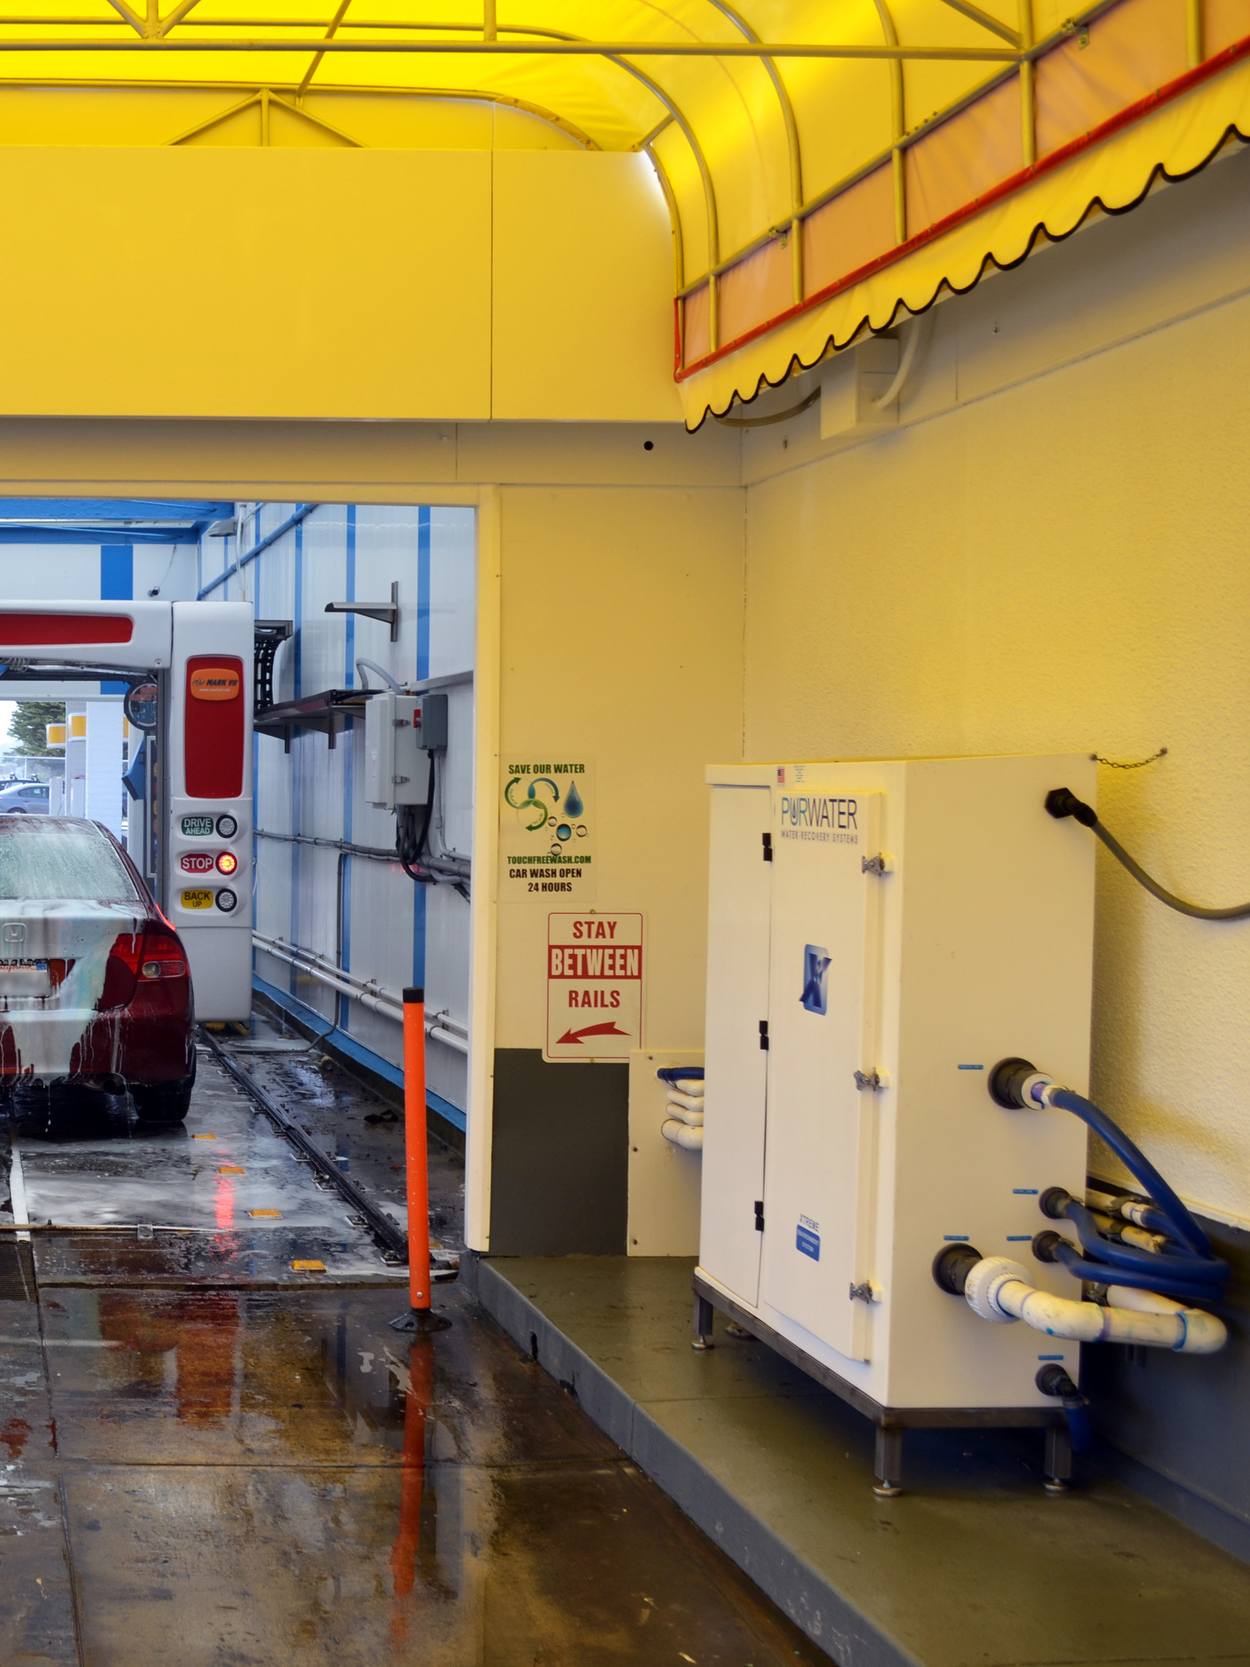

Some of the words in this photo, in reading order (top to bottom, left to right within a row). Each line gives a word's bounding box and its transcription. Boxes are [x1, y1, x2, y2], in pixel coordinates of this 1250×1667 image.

[509, 765, 531, 774] SAVE
[533, 764, 551, 773] OUR
[554, 764, 585, 773] WATER
[184, 819, 211, 827] DRIVE
[782, 830, 798, 839] WATER
[801, 831, 829, 841] RECOVERY
[833, 834, 858, 844] SYSTEMS
[182, 858, 212, 869] STOP
[507, 856, 591, 864] TOUCHFREEWASH.COM
[509, 869, 527, 878] CAR
[529, 869, 557, 878] WASH
[559, 868, 581, 878] OPEN
[528, 883, 539, 892] 24
[542, 882, 572, 892] HOURS
[184, 892, 210, 900] BACK
[573, 921, 617, 939] STAY
[551, 949, 639, 976] BETWEEN
[568, 990, 620, 1008] RAILS
[800, 1214, 820, 1232] XTREME
